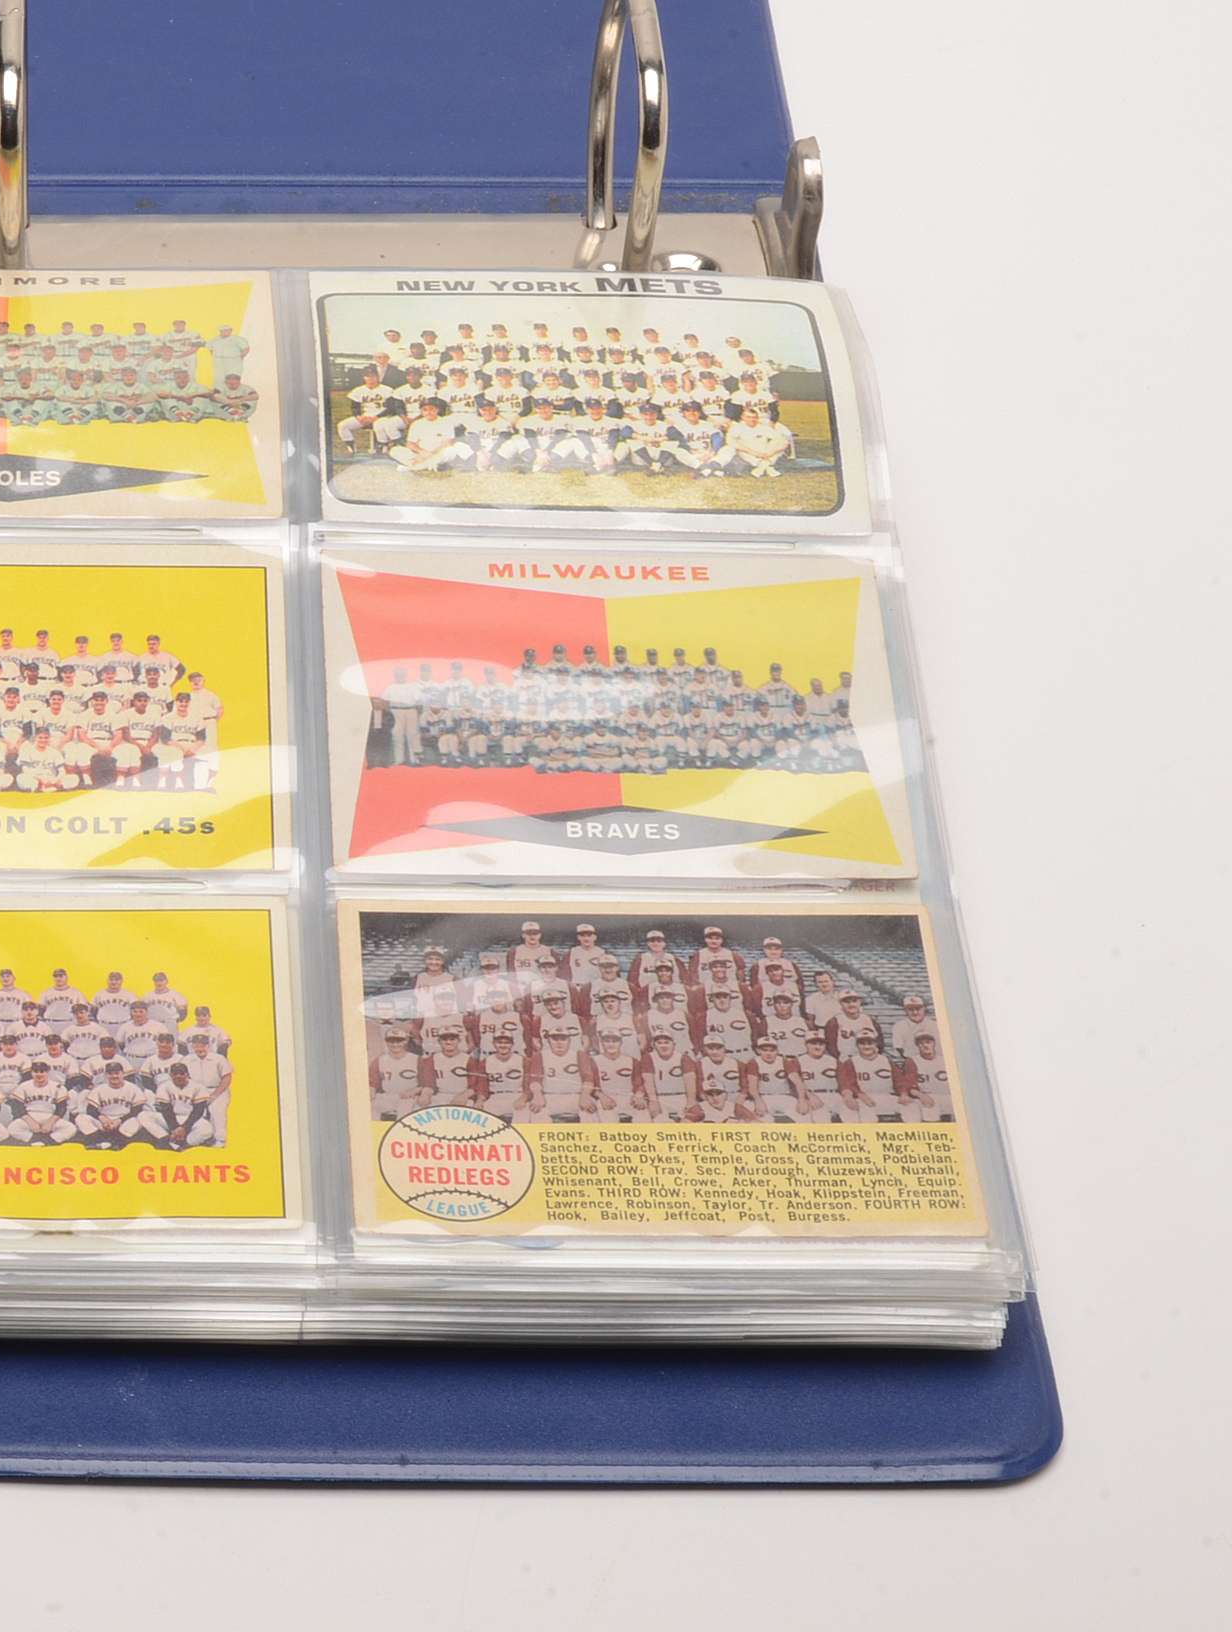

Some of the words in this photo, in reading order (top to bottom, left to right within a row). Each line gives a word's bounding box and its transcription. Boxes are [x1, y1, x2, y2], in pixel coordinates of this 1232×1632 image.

[396, 280, 475, 292] NEW
[490, 281, 583, 293] YORK
[594, 277, 723, 296] METS
[488, 562, 711, 582] MILWAUKEE
[44, 816, 129, 835] COLT
[141, 816, 217, 836] .45s
[566, 821, 682, 840] BRAVES
[413, 1108, 489, 1128] NATIONAL
[539, 1132, 590, 1141] FRONT:
[600, 1132, 647, 1143] Batboy
[656, 1132, 702, 1141] Smith.
[711, 1132, 751, 1141] FIRST
[761, 1132, 798, 1141] ROW:
[807, 1132, 867, 1143] Henrich,
[876, 1132, 954, 1143] MacMillan,
[391, 1142, 523, 1161] CINCINNATI
[540, 1143, 603, 1154] Sanchez,
[614, 1143, 656, 1152] Coach
[669, 1143, 723, 1154] Ferrick,
[735, 1143, 776, 1152] Coach
[788, 1143, 871, 1154] McCormick,
[882, 1143, 914, 1154] Mgr.
[925, 1143, 956, 1152] Teb-
[541, 1155, 582, 1165] betts,
[590, 1155, 632, 1164] Coach
[640, 1155, 685, 1165] Dykes,
[692, 1155, 748, 1165] Temple,
[756, 1155, 800, 1165] Gross,
[806, 1155, 877, 1165] Grammas,
[883, 1155, 957, 1164] Podbielan.
[137, 1164, 252, 1185] GIANTS
[408, 1166, 511, 1186] REDLEGS
[542, 1166, 599, 1175] SECOND
[607, 1166, 644, 1175] ROW:
[653, 1166, 688, 1175] Trav.
[697, 1166, 726, 1175] Sec.
[735, 1166, 809, 1177] Murdough,
[817, 1166, 893, 1177] Kluzewski,
[901, 1166, 960, 1177] Nuxhall,
[543, 1177, 622, 1188] Whisenant,
[632, 1177, 664, 1188] Bell,
[674, 1177, 723, 1188] Crowe,
[733, 1177, 777, 1188] Acker,
[786, 1177, 853, 1188] Thurman,
[862, 1177, 908, 1188] Lynch,
[918, 1177, 961, 1188] Equip.
[545, 1188, 591, 1198] Evans.
[597, 1188, 642, 1198] THIRD
[650, 1188, 687, 1198] ROW:
[694, 1188, 759, 1199] Kennedy,
[767, 1188, 806, 1199] Hoak,
[813, 1188, 891, 1199] Klippstein,
[898, 1188, 964, 1199] Freeman,
[426, 1200, 490, 1216] LEAGUE
[546, 1200, 619, 1211] Lawrence,
[627, 1200, 695, 1211] Robinson,
[704, 1200, 751, 1211] Taylor,
[760, 1200, 779, 1209] Tr.
[787, 1200, 857, 1209] Anderson.
[865, 1200, 921, 1209] FOURTH
[929, 1200, 966, 1209] ROW:
[547, 1211, 587, 1222] Hook,
[601, 1211, 650, 1222] Bailey,
[664, 1211, 726, 1222] Jeffcoat,
[739, 1211, 775, 1222] Post,
[788, 1211, 851, 1222] Burgess.
